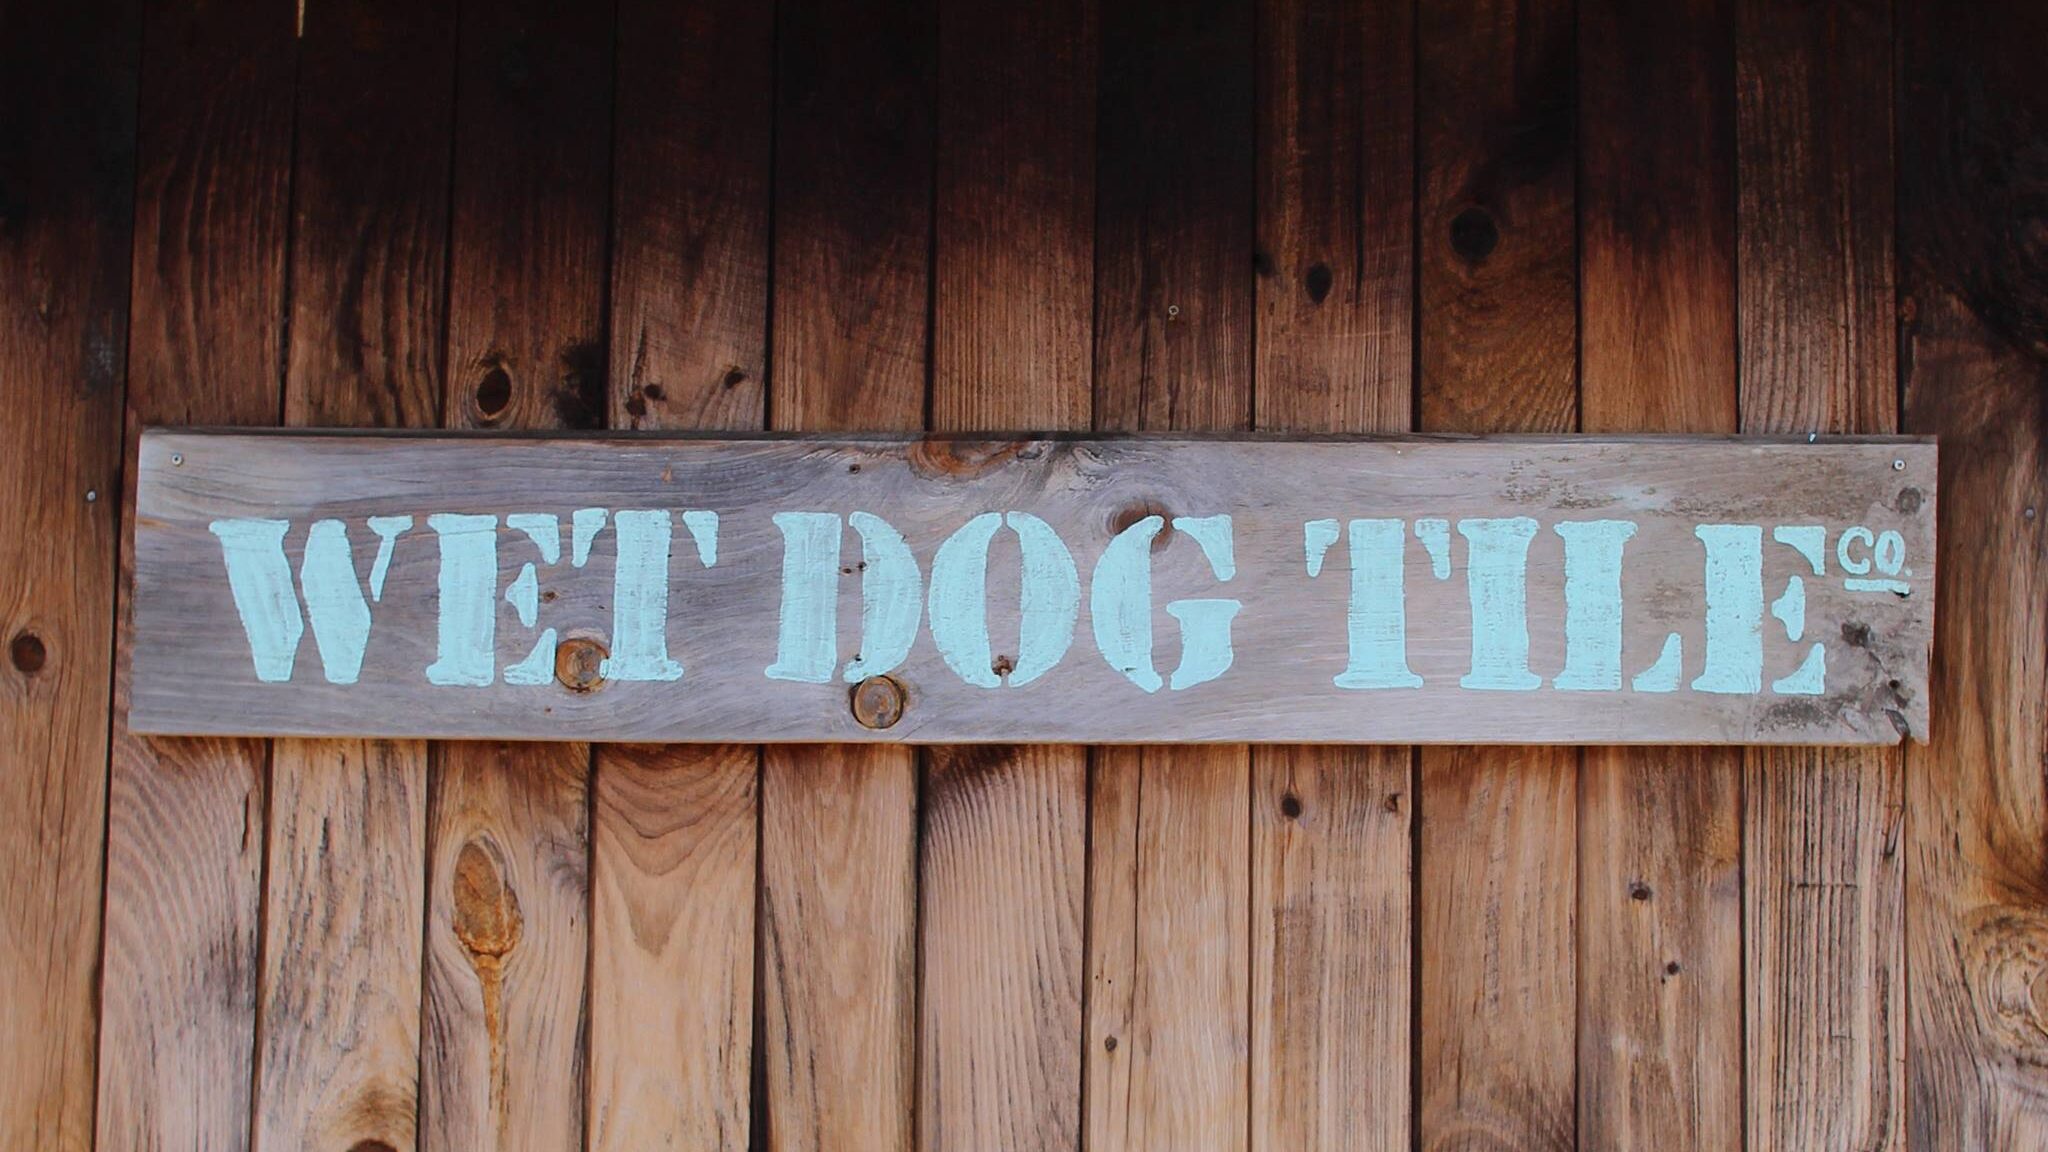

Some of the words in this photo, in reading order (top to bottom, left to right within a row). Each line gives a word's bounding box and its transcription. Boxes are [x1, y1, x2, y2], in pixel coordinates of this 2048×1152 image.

[208, 507, 721, 689] WET
[763, 510, 1243, 695] DOG
[1303, 517, 1826, 696] TILE
